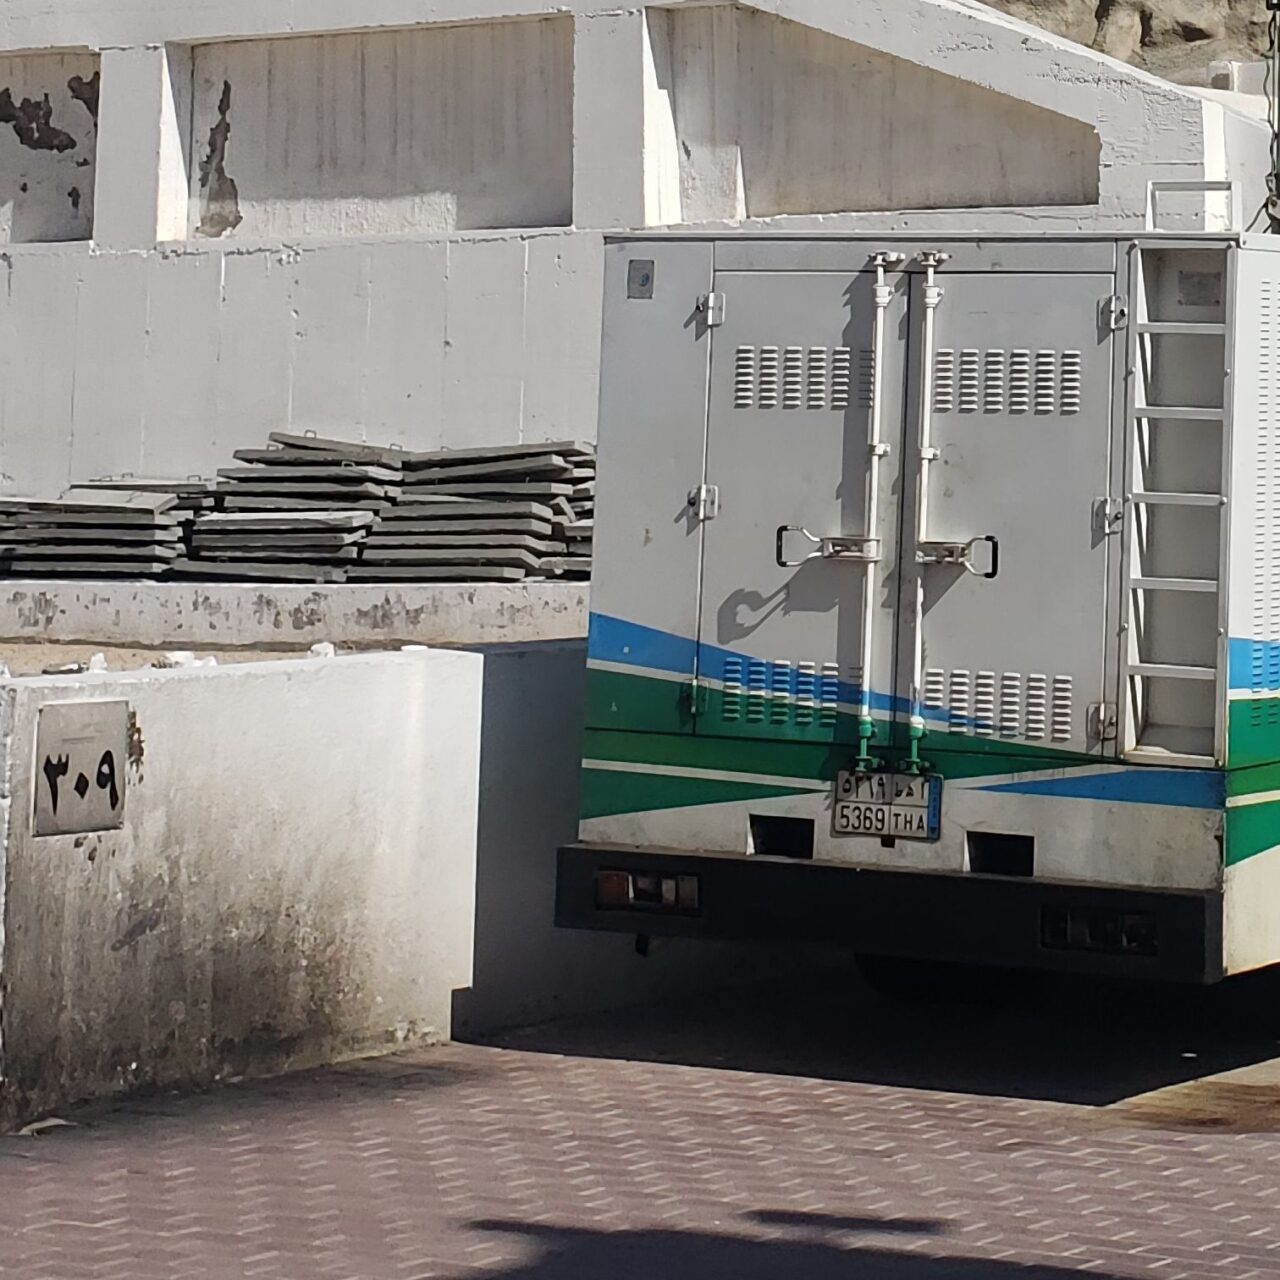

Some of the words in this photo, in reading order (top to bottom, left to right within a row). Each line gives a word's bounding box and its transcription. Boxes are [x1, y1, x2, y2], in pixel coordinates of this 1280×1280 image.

[42, 750, 119, 816] ٣٠٩
[840, 805, 885, 832] 5369
[893, 813, 925, 832] THA
